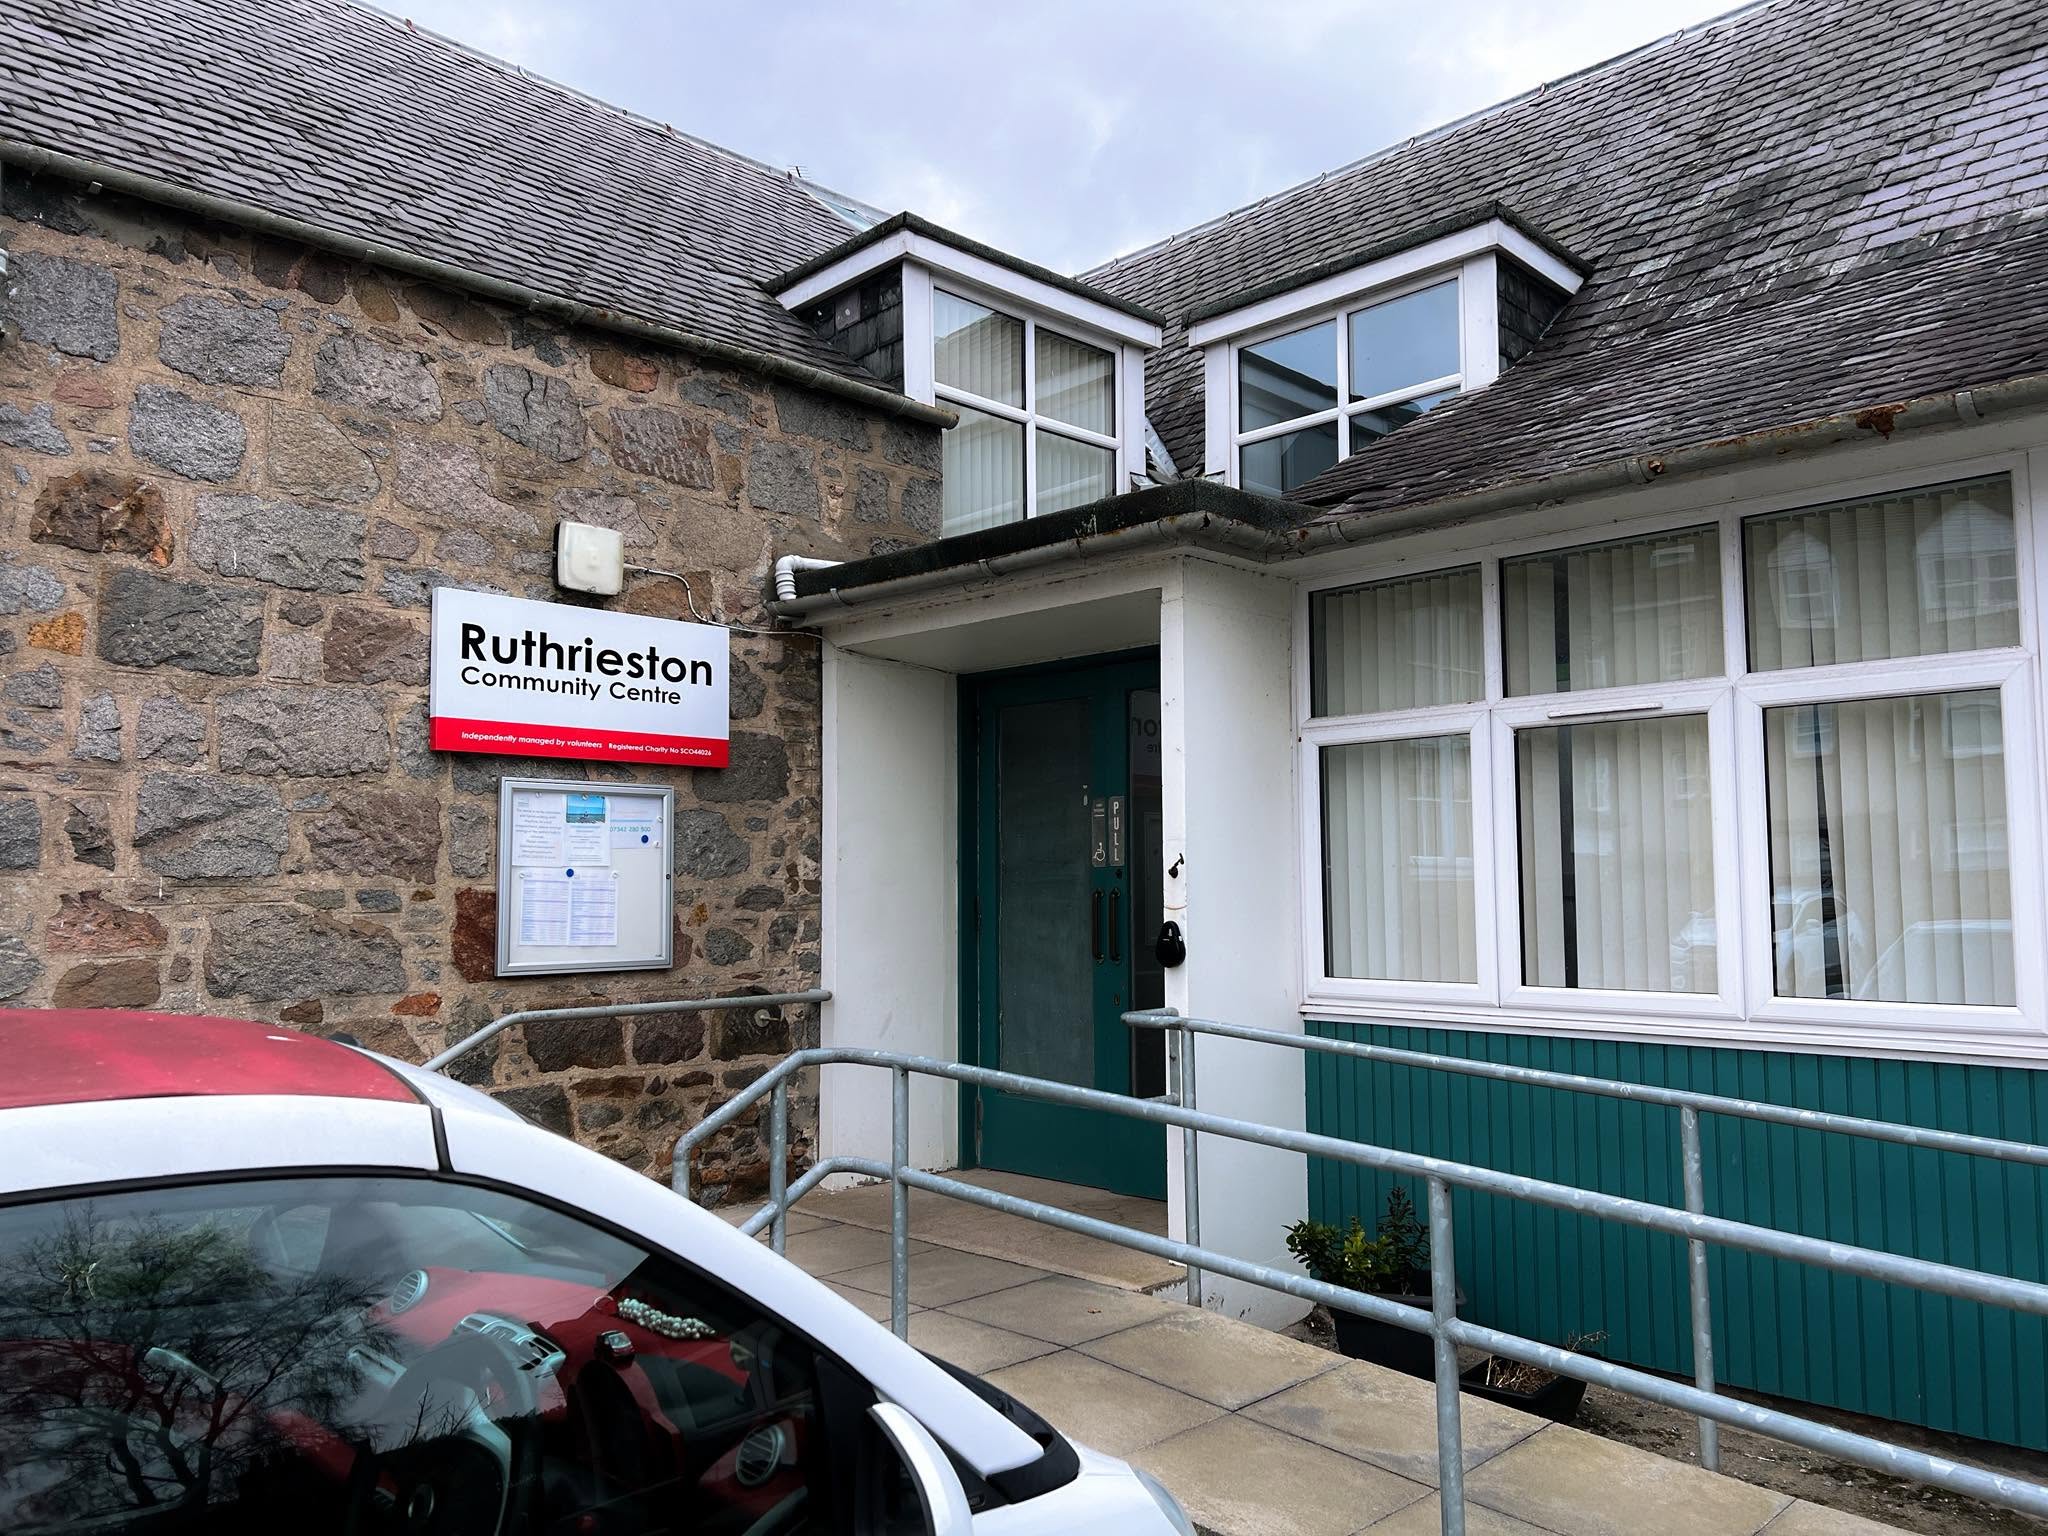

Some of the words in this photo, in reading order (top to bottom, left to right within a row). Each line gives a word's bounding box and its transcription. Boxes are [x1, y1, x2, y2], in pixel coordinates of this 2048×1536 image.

[461, 622, 713, 687] Ruthrieston
[461, 666, 602, 701] Community
[609, 681, 682, 705] Centre
[461, 732, 518, 744] Independently
[518, 736, 555, 747] managed
[556, 737, 566, 748] by
[567, 739, 603, 749] volunteers
[608, 742, 644, 753] Registered
[645, 745, 669, 755] Charity
[670, 746, 680, 754] No
